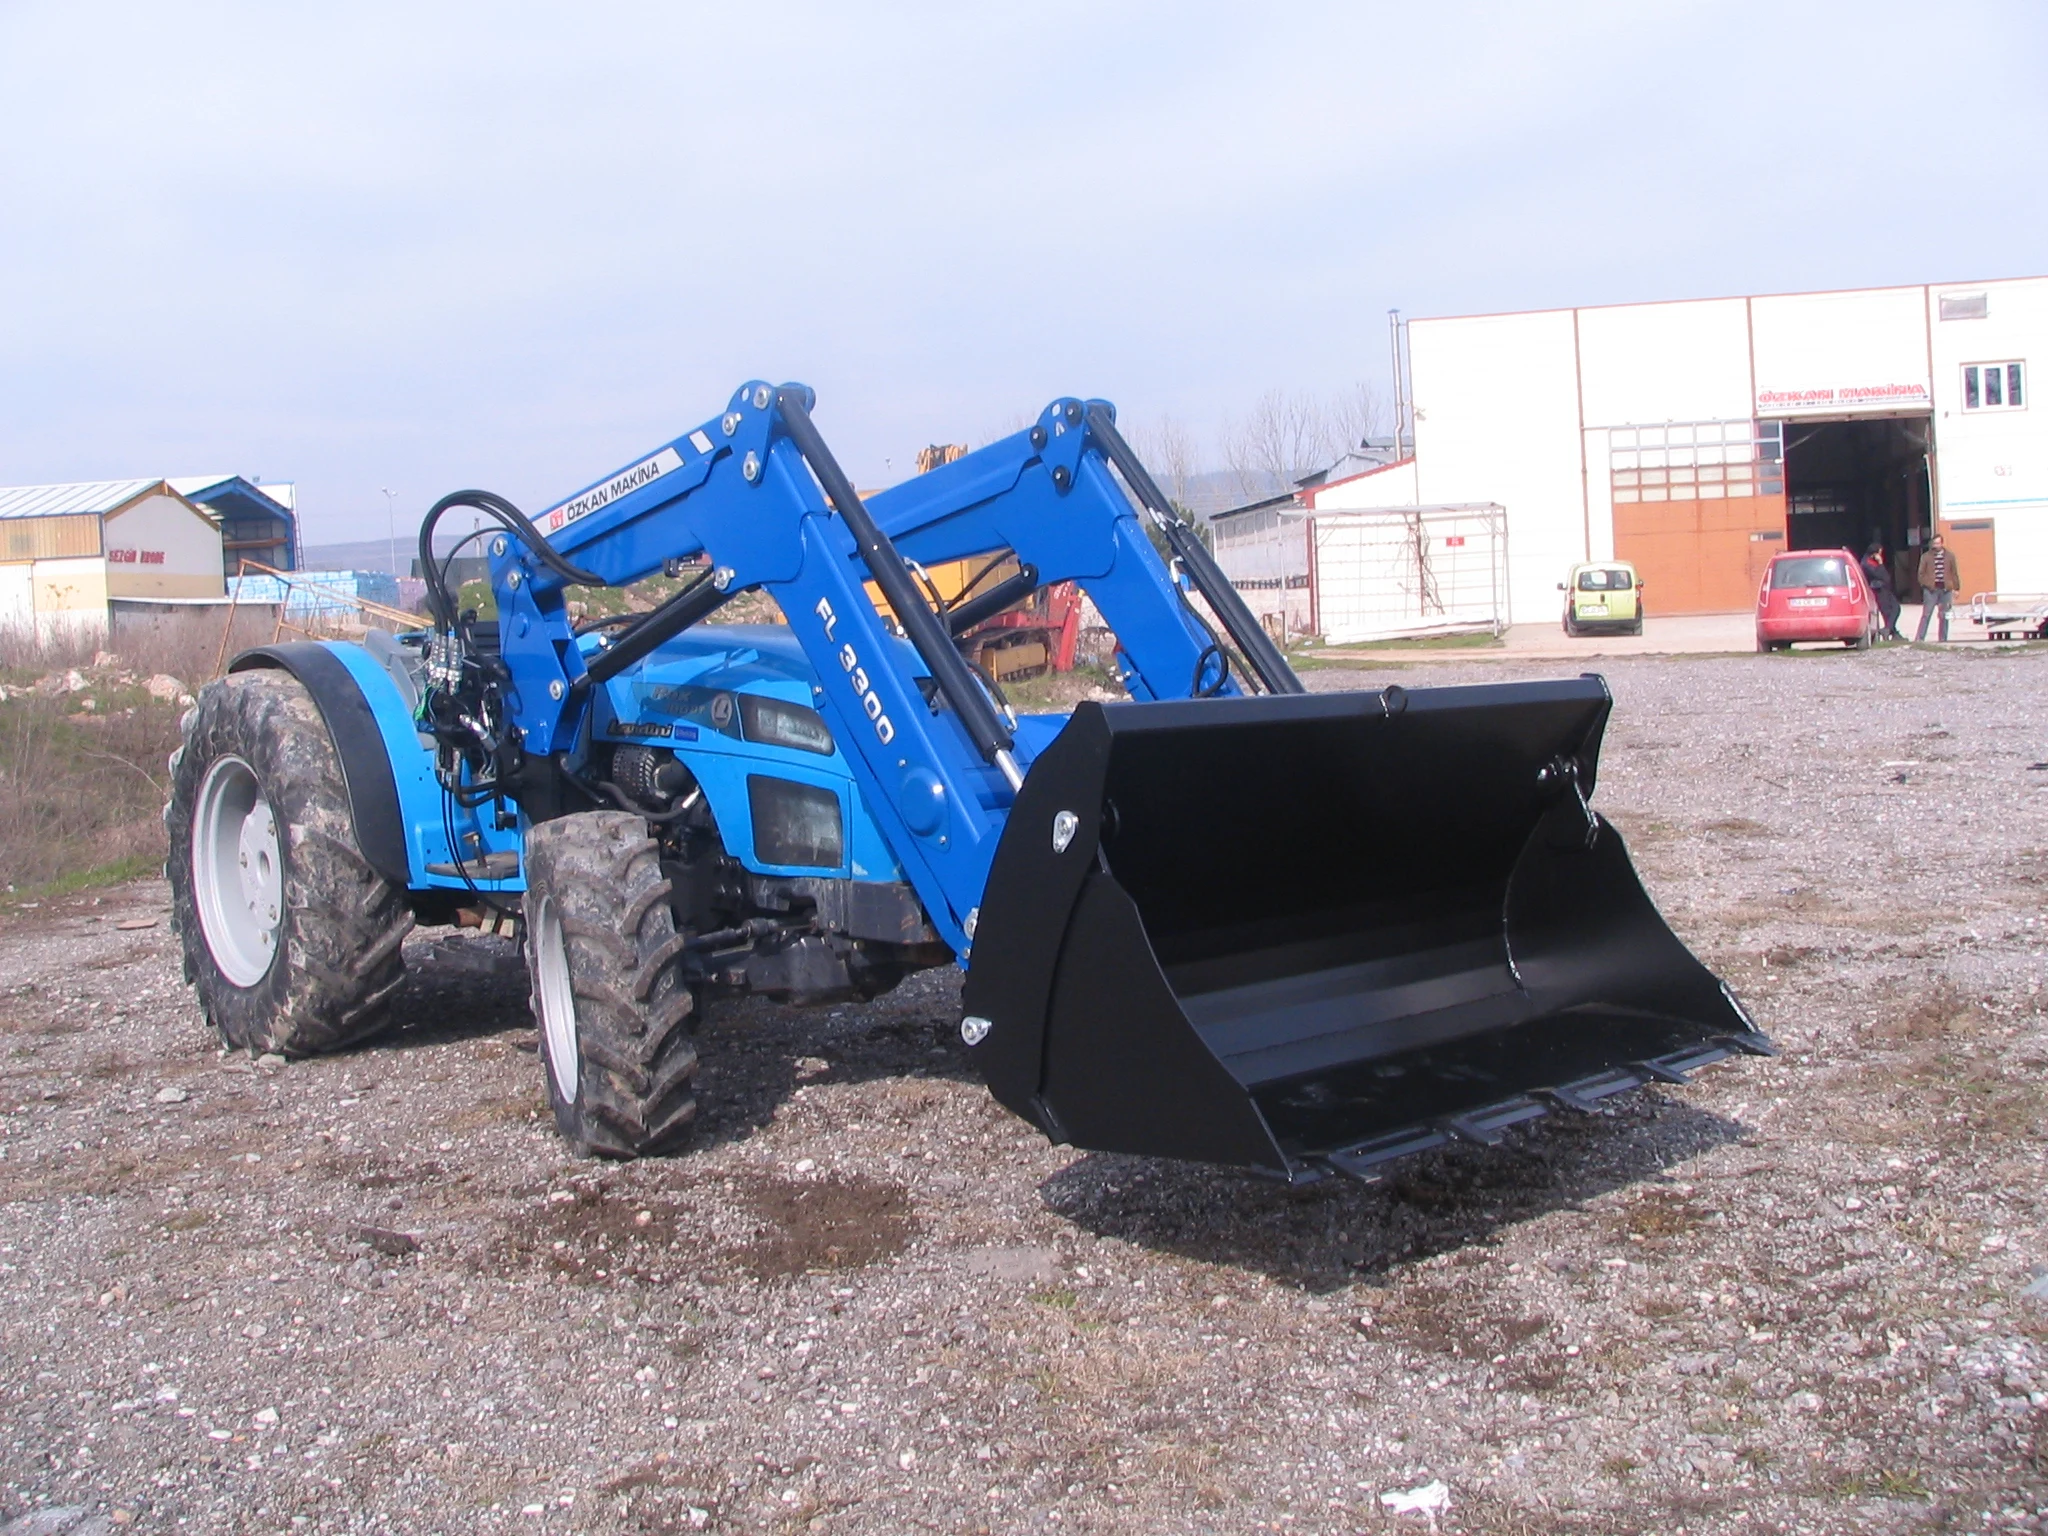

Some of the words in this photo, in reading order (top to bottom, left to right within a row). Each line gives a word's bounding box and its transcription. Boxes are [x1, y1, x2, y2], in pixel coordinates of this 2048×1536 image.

[566, 489, 609, 522] ÖZKAN
[610, 462, 660, 499] MAKİNA
[815, 596, 837, 643] FL
[839, 643, 895, 746] 3300
